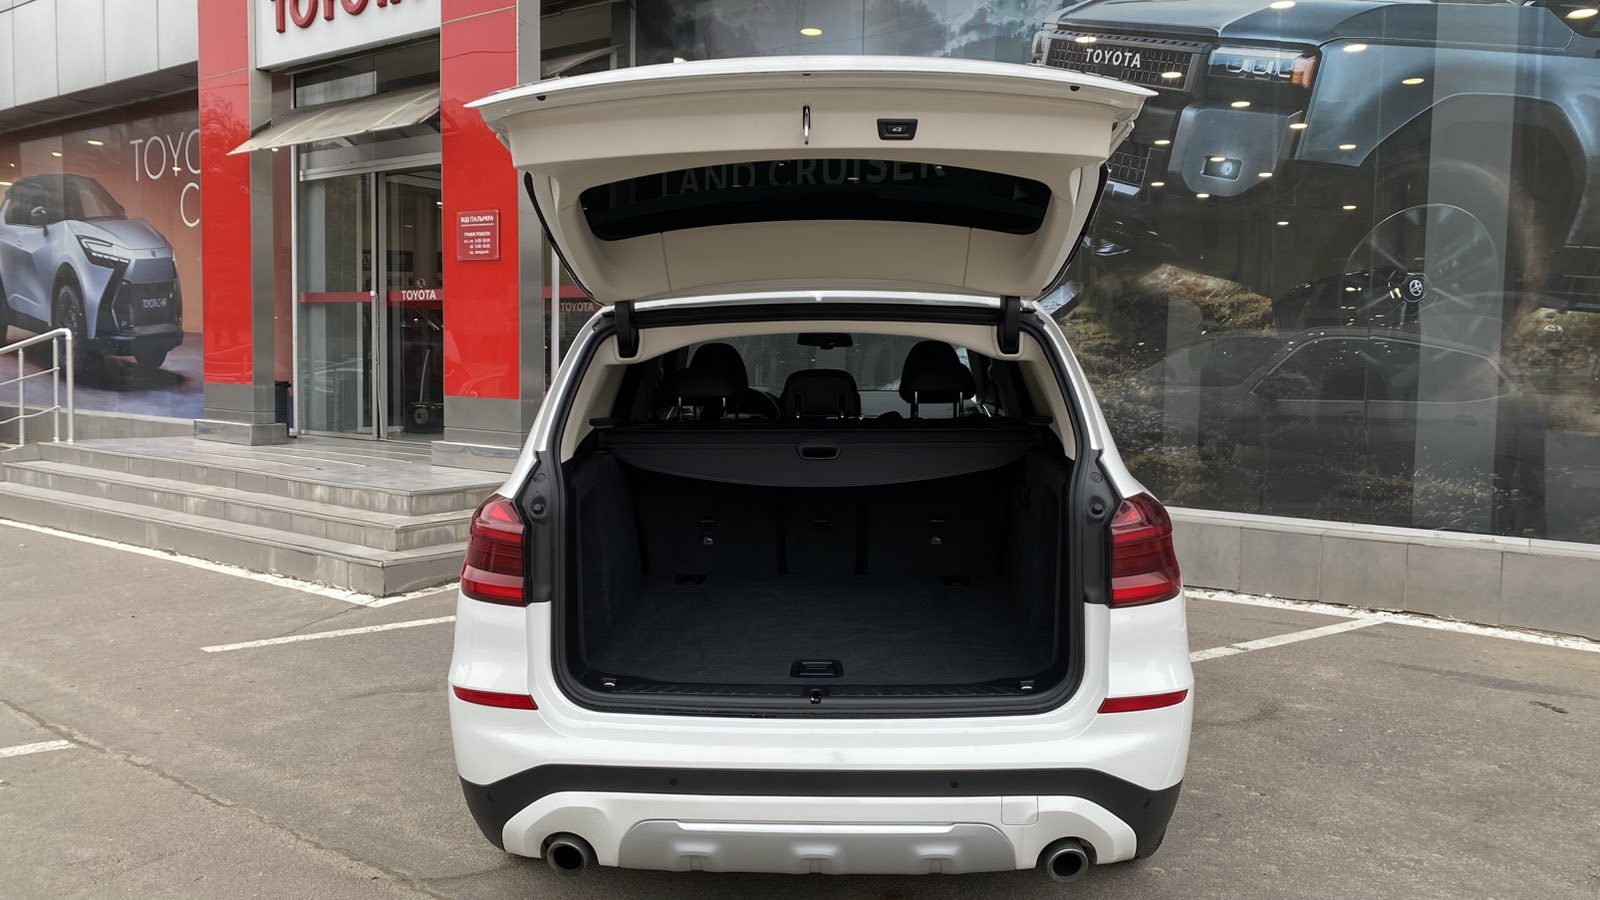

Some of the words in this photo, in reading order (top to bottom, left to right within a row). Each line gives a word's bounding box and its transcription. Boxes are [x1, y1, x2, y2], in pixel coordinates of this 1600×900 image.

[1086, 48, 1140, 68] TOYOTA
[662, 163, 756, 197] LAND
[401, 290, 436, 300] TOYOTA
[561, 302, 594, 311] TOYOTA
